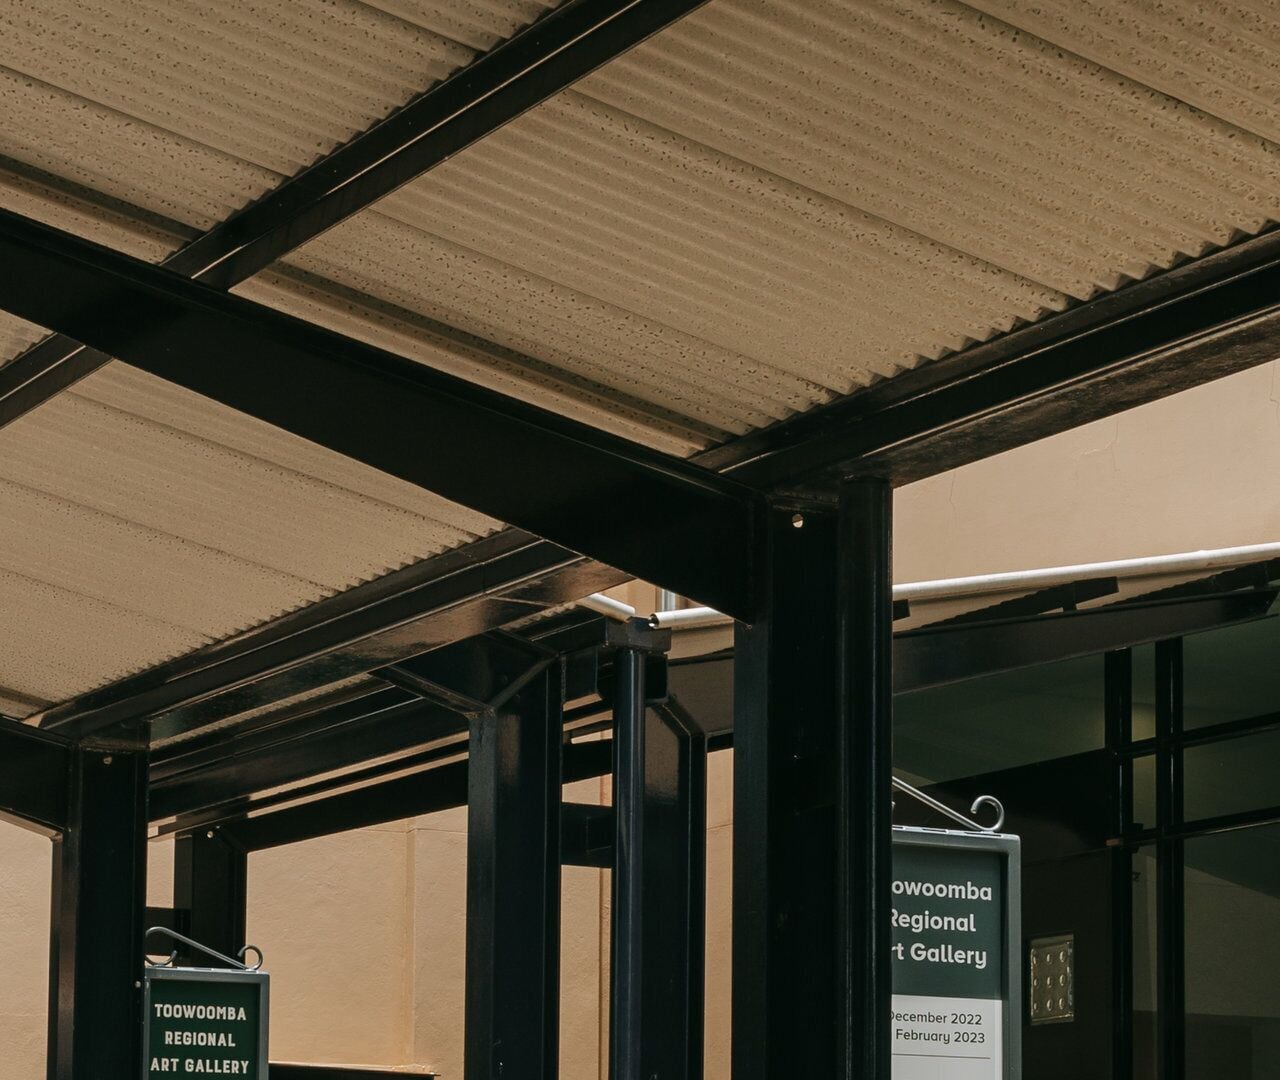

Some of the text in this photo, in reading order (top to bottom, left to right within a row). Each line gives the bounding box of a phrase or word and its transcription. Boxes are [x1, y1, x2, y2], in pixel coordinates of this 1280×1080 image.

[892, 881, 992, 900] owoomba
[910, 943, 986, 969] Gallery
[155, 1004, 246, 1020] TOOWOOMBA
[951, 1013, 982, 1025] 2022
[165, 1031, 236, 1047] REGIONAL
[896, 1029, 985, 1044] February 2023
[151, 1058, 249, 1074] ART GALLERY
